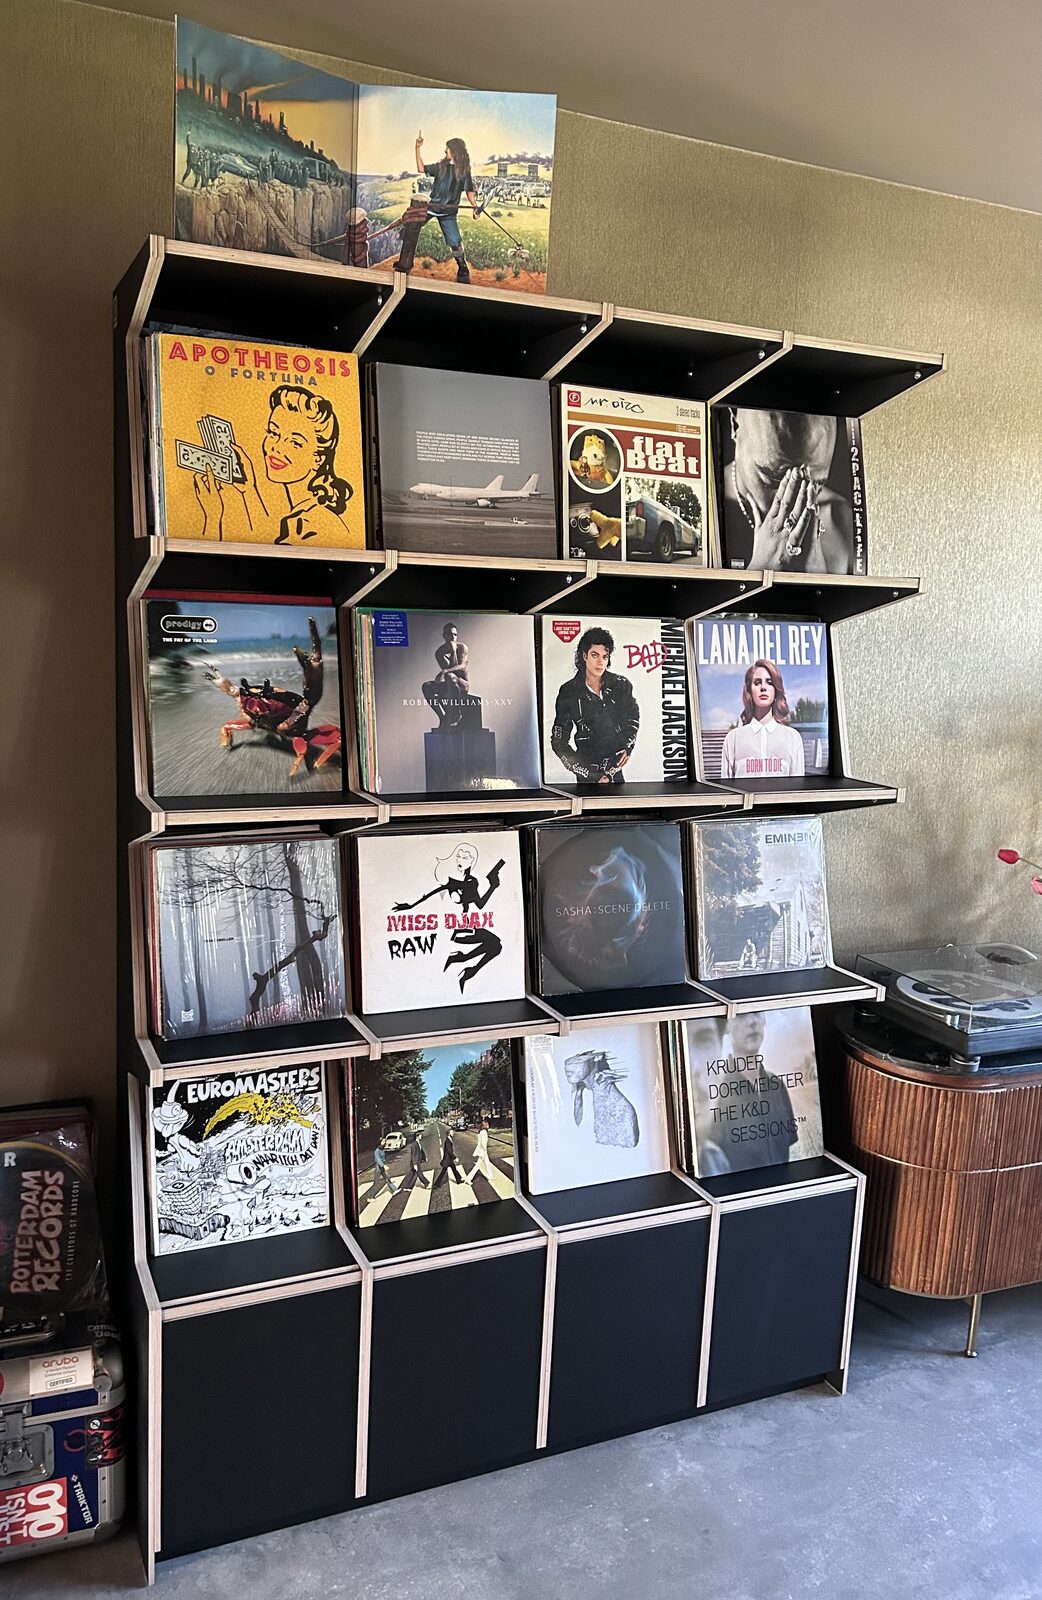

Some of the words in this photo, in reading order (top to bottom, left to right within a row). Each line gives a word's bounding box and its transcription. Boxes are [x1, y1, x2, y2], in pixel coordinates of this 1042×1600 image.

[169, 341, 351, 377] APOTHEOSIS
[204, 366, 216, 376] O
[230, 367, 318, 386] FORTUNA
[632, 435, 685, 458] flat
[626, 448, 699, 475] Beat
[165, 620, 202, 630] prodigy
[623, 640, 668, 673] BAD
[660, 619, 686, 698] MICHAEL
[698, 624, 750, 665] LANA
[752, 624, 786, 665] DEL
[788, 625, 822, 666] REY
[402, 698, 438, 706] ROBBIE
[441, 698, 490, 706] WILLIAMS
[662, 699, 688, 783] JACKSON
[746, 758, 763, 772] BORN
[764, 758, 773, 772] TO
[773, 758, 783, 772] DIE
[598, 904, 631, 914] SCENE
[634, 902, 671, 911] DELETE
[387, 914, 438, 932] MISS
[388, 933, 437, 960] RAW
[706, 1054, 764, 1076] KRUDER
[187, 1066, 320, 1104] EUROMASTERS
[709, 1072, 804, 1100] DORFMEISTER
[710, 1105, 738, 1123] THE
[742, 1100, 770, 1119] K&D
[224, 1128, 304, 1163] AMSTERDAM
[70, 1180, 80, 1216] HARDCORE
[10, 1170, 42, 1294] ROTTERDAM
[31, 1170, 65, 1292] RECORDS
[66, 1231, 76, 1266] CREATORS
[42, 1355, 79, 1368] aruba
[49, 1377, 73, 1387] CERTIFIED
[6, 1492, 28, 1538] ISN'T
[73, 1482, 93, 1524] TRAKTOR
